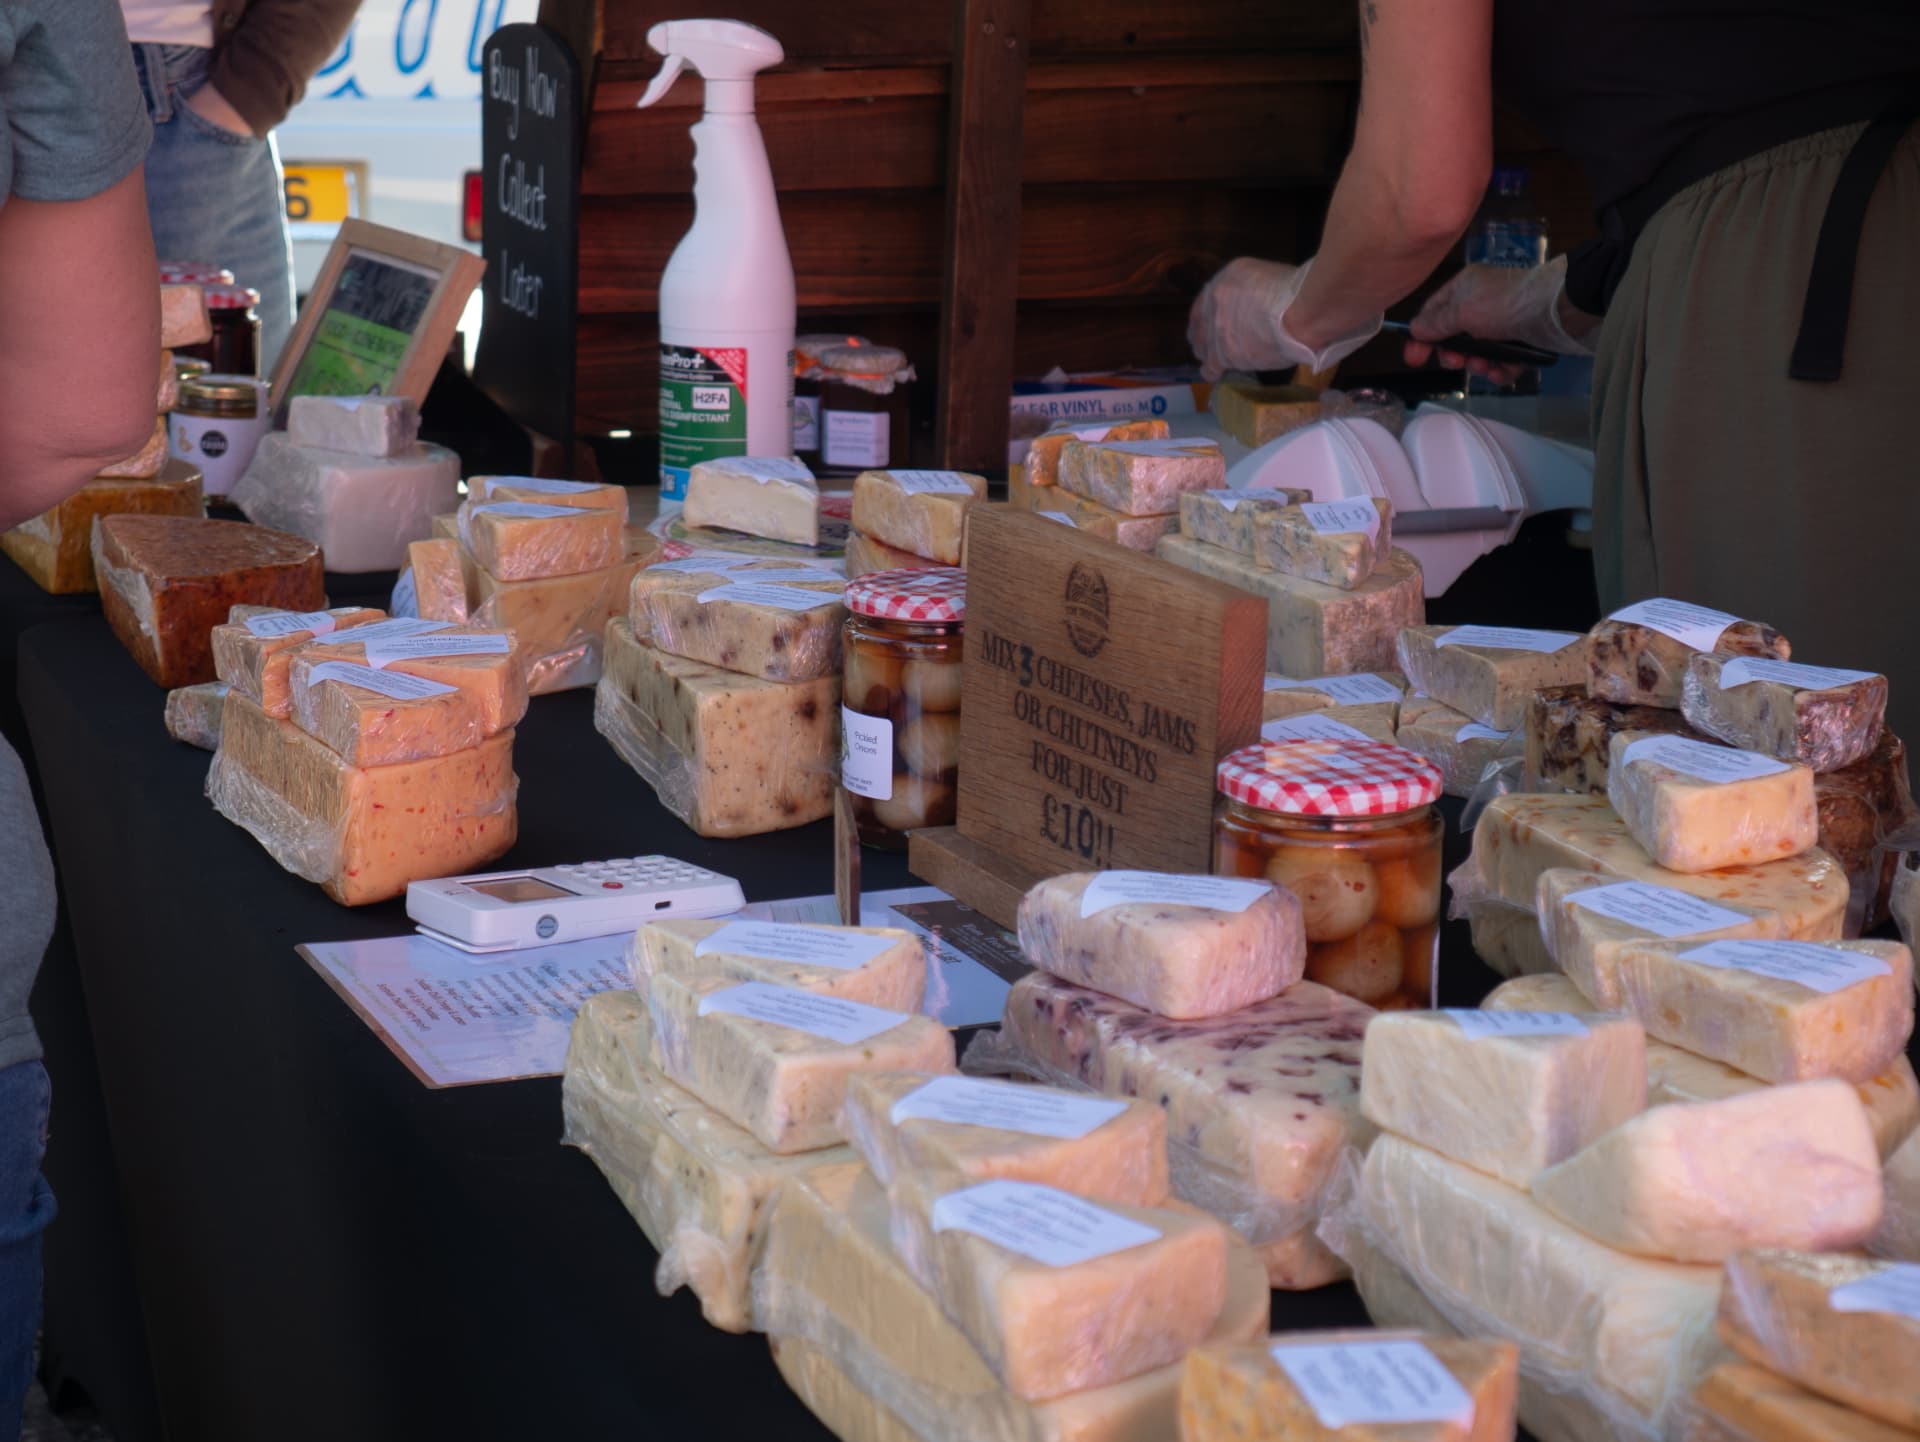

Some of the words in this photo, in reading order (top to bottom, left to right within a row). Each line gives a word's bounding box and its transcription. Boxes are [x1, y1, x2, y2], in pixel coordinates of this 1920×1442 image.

[489, 48, 520, 140] Buy
[526, 46, 557, 119] Now
[499, 153, 547, 231] Collect
[695, 392, 728, 404] H2FA
[1061, 399, 1106, 416] VINYL
[981, 630, 1017, 673] MIX
[1019, 643, 1034, 688] 3
[1037, 655, 1134, 733] CHEESES,
[1138, 701, 1197, 755] JAMS
[1014, 690, 1042, 729] OR
[1046, 704, 1158, 784] CHUTNEYS
[1032, 739, 1072, 789] FOR
[1075, 763, 1129, 815] JUST
